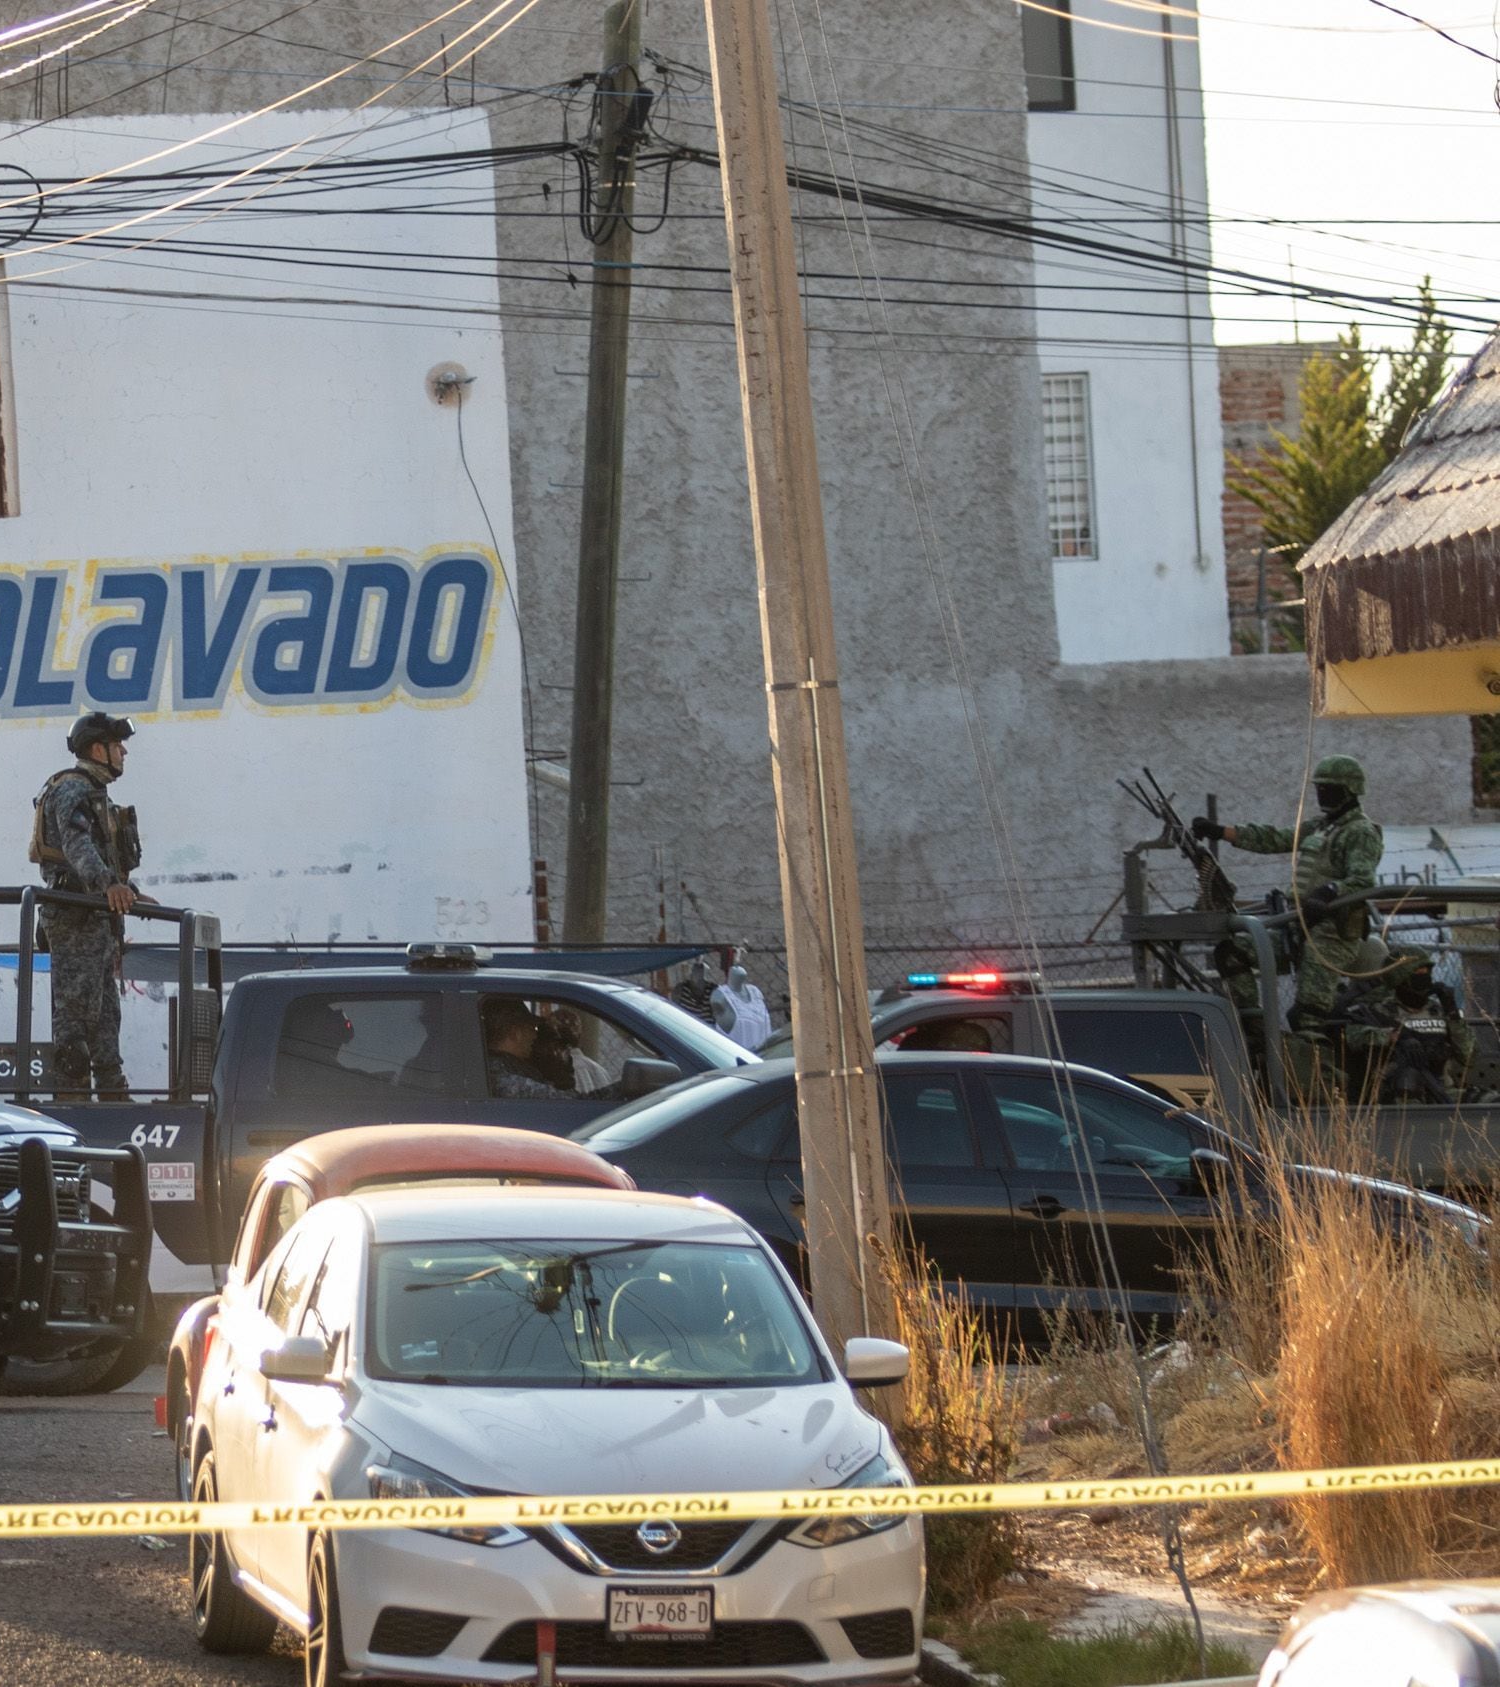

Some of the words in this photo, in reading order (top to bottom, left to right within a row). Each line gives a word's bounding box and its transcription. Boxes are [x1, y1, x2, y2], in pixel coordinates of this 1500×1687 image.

[131, 1123, 181, 1149] 647
[151, 1166, 190, 1179] 911
[613, 1601, 709, 1623] ZFV-968-D
